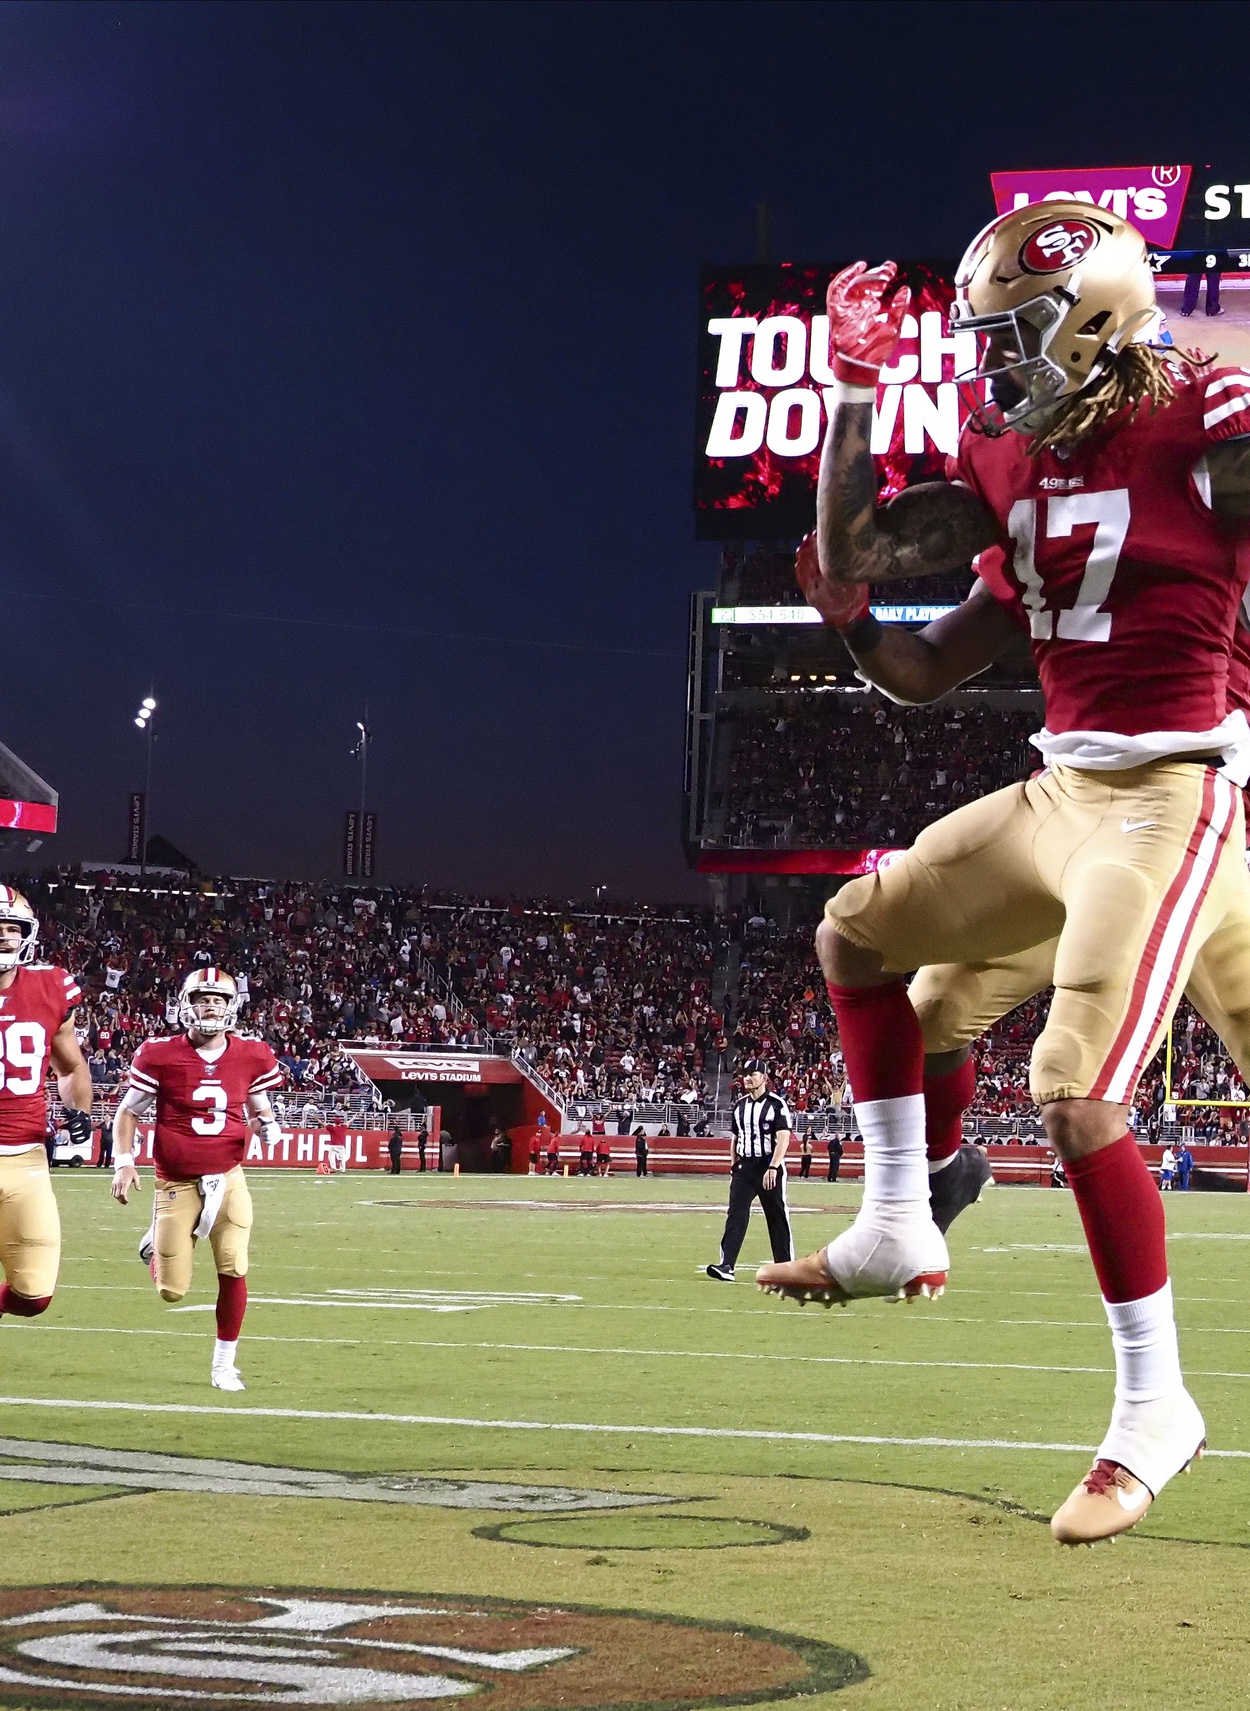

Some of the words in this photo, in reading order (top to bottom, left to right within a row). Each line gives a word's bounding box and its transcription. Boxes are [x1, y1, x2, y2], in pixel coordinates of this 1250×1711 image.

[1206, 255, 1216, 268] 9
[1008, 488, 1131, 642] 17
[401, 1071, 438, 1080] LEVI'S
[439, 1073, 481, 1082] STADIUM
[191, 1086, 228, 1135] 3
